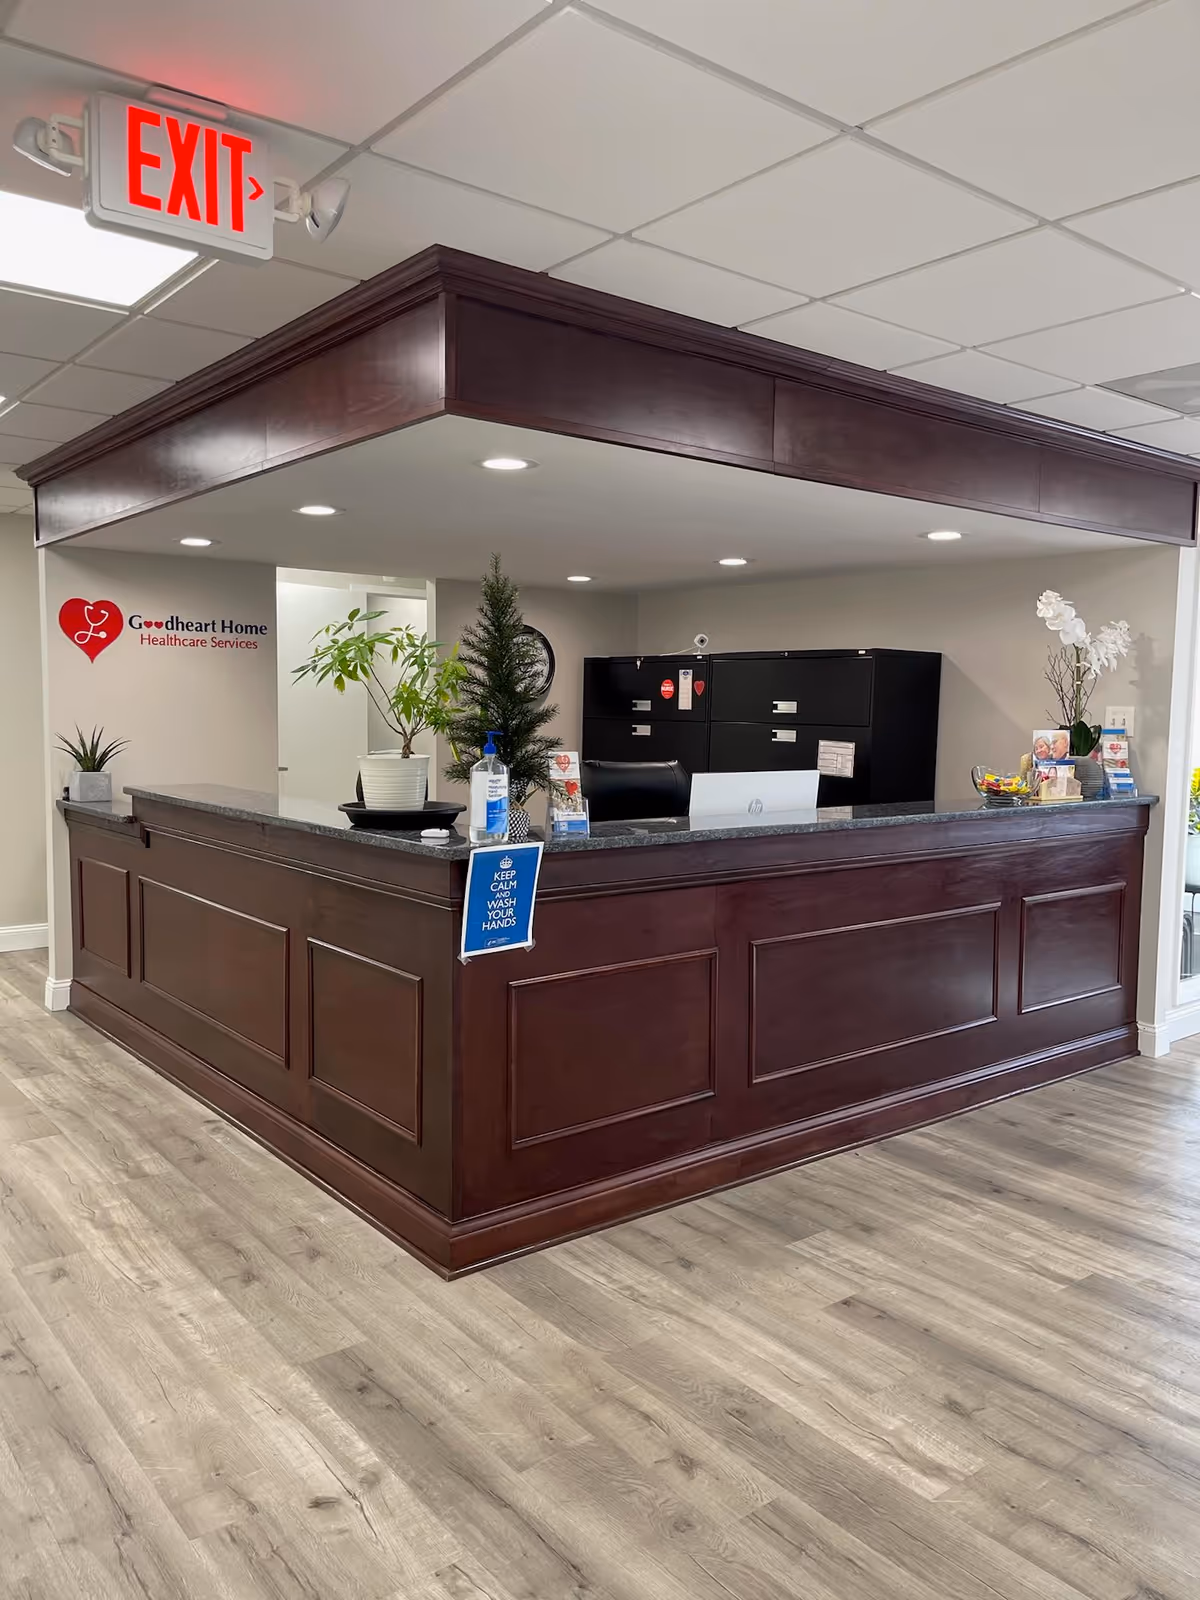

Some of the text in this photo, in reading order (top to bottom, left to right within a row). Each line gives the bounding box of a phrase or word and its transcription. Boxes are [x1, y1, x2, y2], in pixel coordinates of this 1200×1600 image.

[128, 105, 252, 232] EXIT
[128, 614, 268, 636] Goodheart Home
[140, 634, 258, 650] Healthcare Services
[493, 870, 516, 881] KEEP
[490, 880, 517, 892] CALM
[495, 890, 510, 899] AND
[487, 897, 517, 910] WASH
[487, 908, 514, 920] YOUR
[482, 917, 517, 931] HANDS
